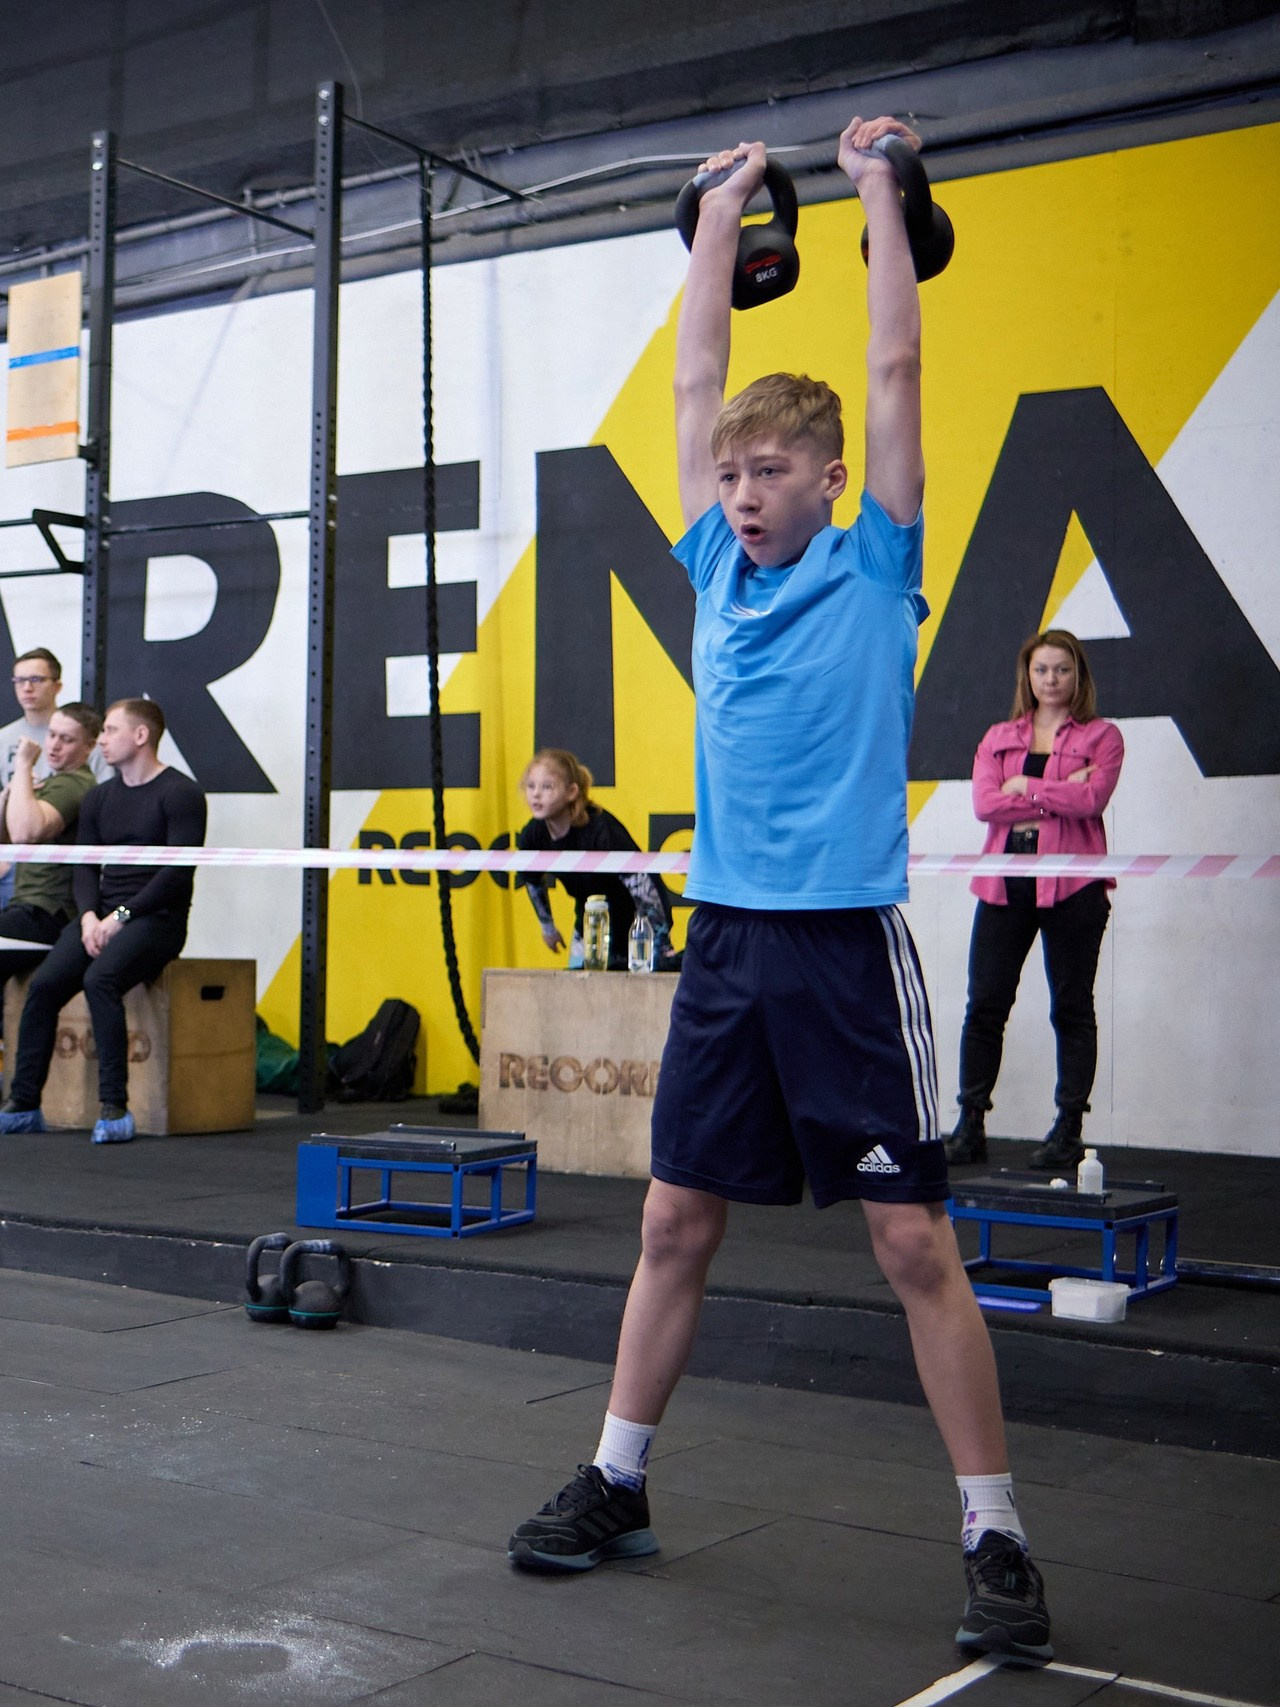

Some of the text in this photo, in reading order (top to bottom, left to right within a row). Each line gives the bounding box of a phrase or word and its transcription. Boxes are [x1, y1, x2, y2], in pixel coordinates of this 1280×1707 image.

[755, 267, 777, 283] 8KG
[499, 1052, 660, 1097] RECOR
[856, 1162, 901, 1173] adidas
